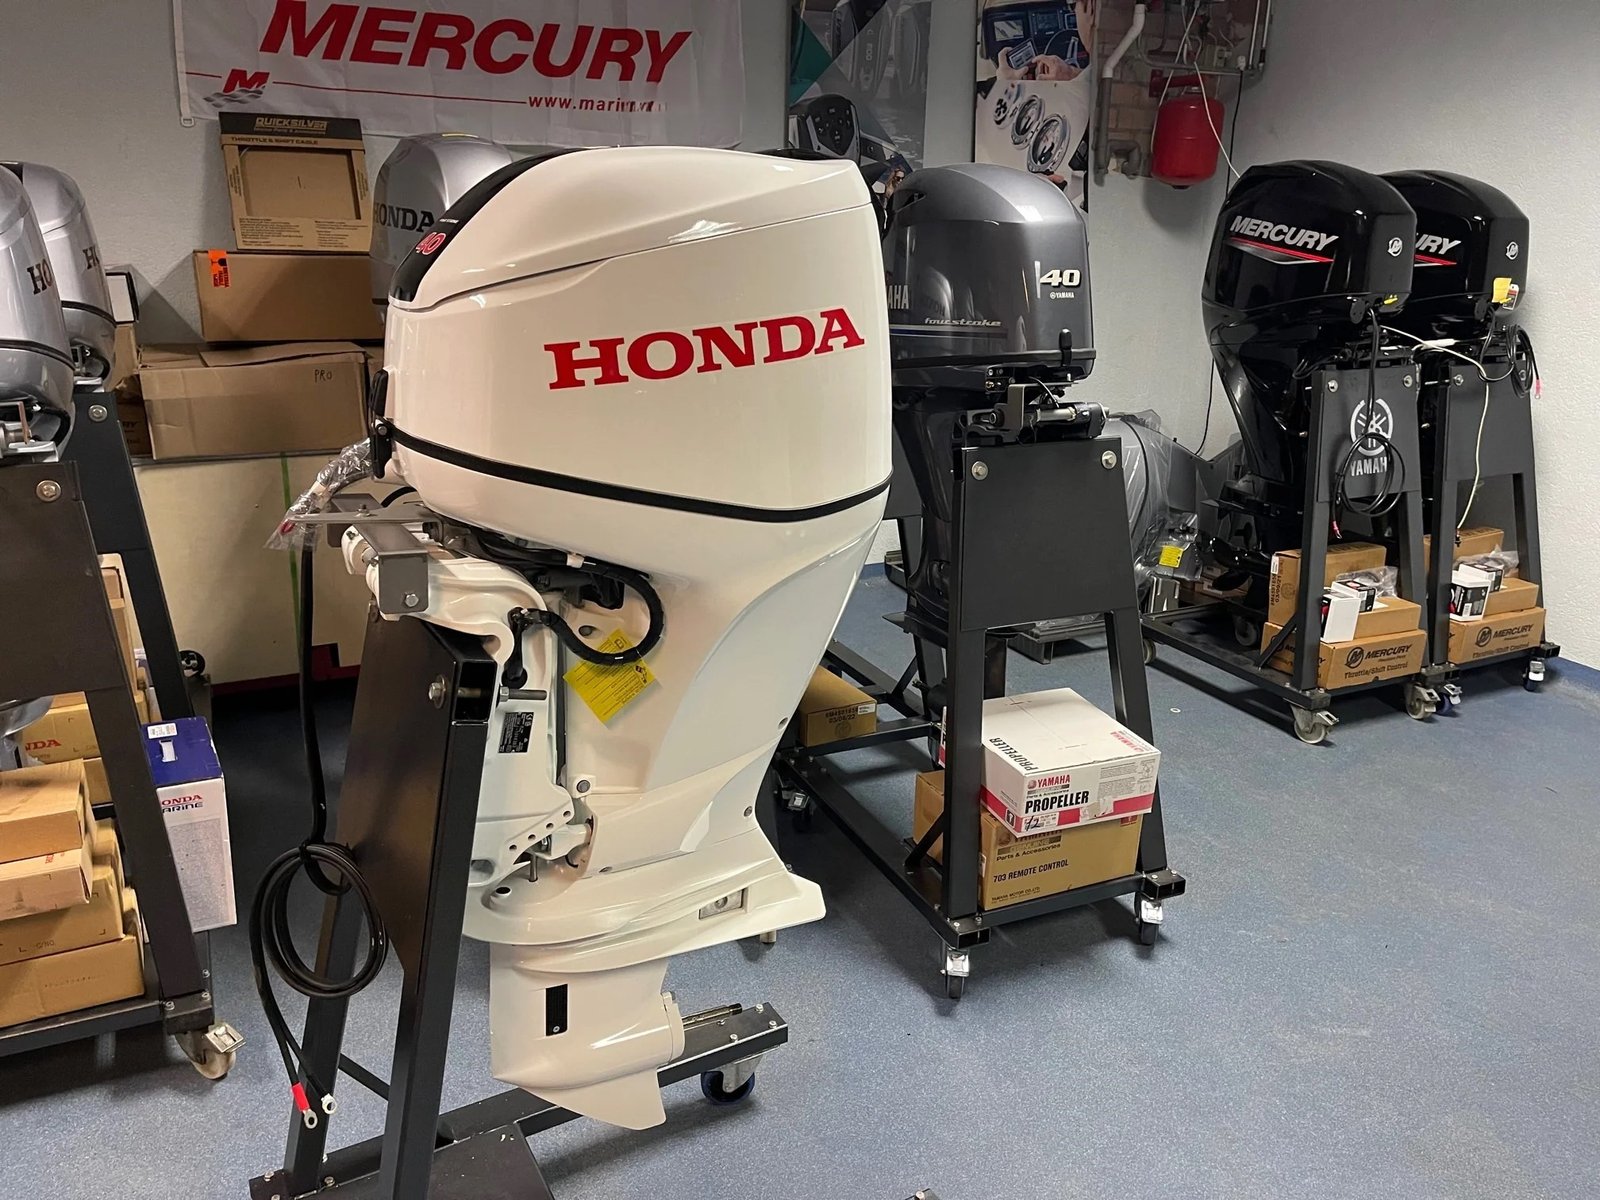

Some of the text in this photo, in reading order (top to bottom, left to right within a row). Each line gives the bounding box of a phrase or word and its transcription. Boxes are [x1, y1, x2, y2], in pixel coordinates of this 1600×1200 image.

[258, 0, 693, 84] MERCURY
[255, 117, 328, 130] QUICKSILVER
[1229, 214, 1340, 252] MERCURY
[1040, 268, 1082, 288] 40
[1055, 291, 1075, 299] YAMAHA
[543, 307, 865, 390] HONDA
[1350, 456, 1387, 477] YAMAH
[1493, 624, 1534, 639] MERCURY
[1364, 643, 1413, 660] MERCURY
[1387, 661, 1408, 671] Control
[989, 737, 1039, 772] PROPELLER
[1038, 774, 1071, 788] YAMAHA
[161, 794, 203, 806] ONDA
[1025, 790, 1089, 814] PROPELLER
[997, 853, 1014, 861] Parts
[1021, 843, 1062, 856] Accessories
[993, 858, 1070, 883] 703 REMOTE CONTROL
